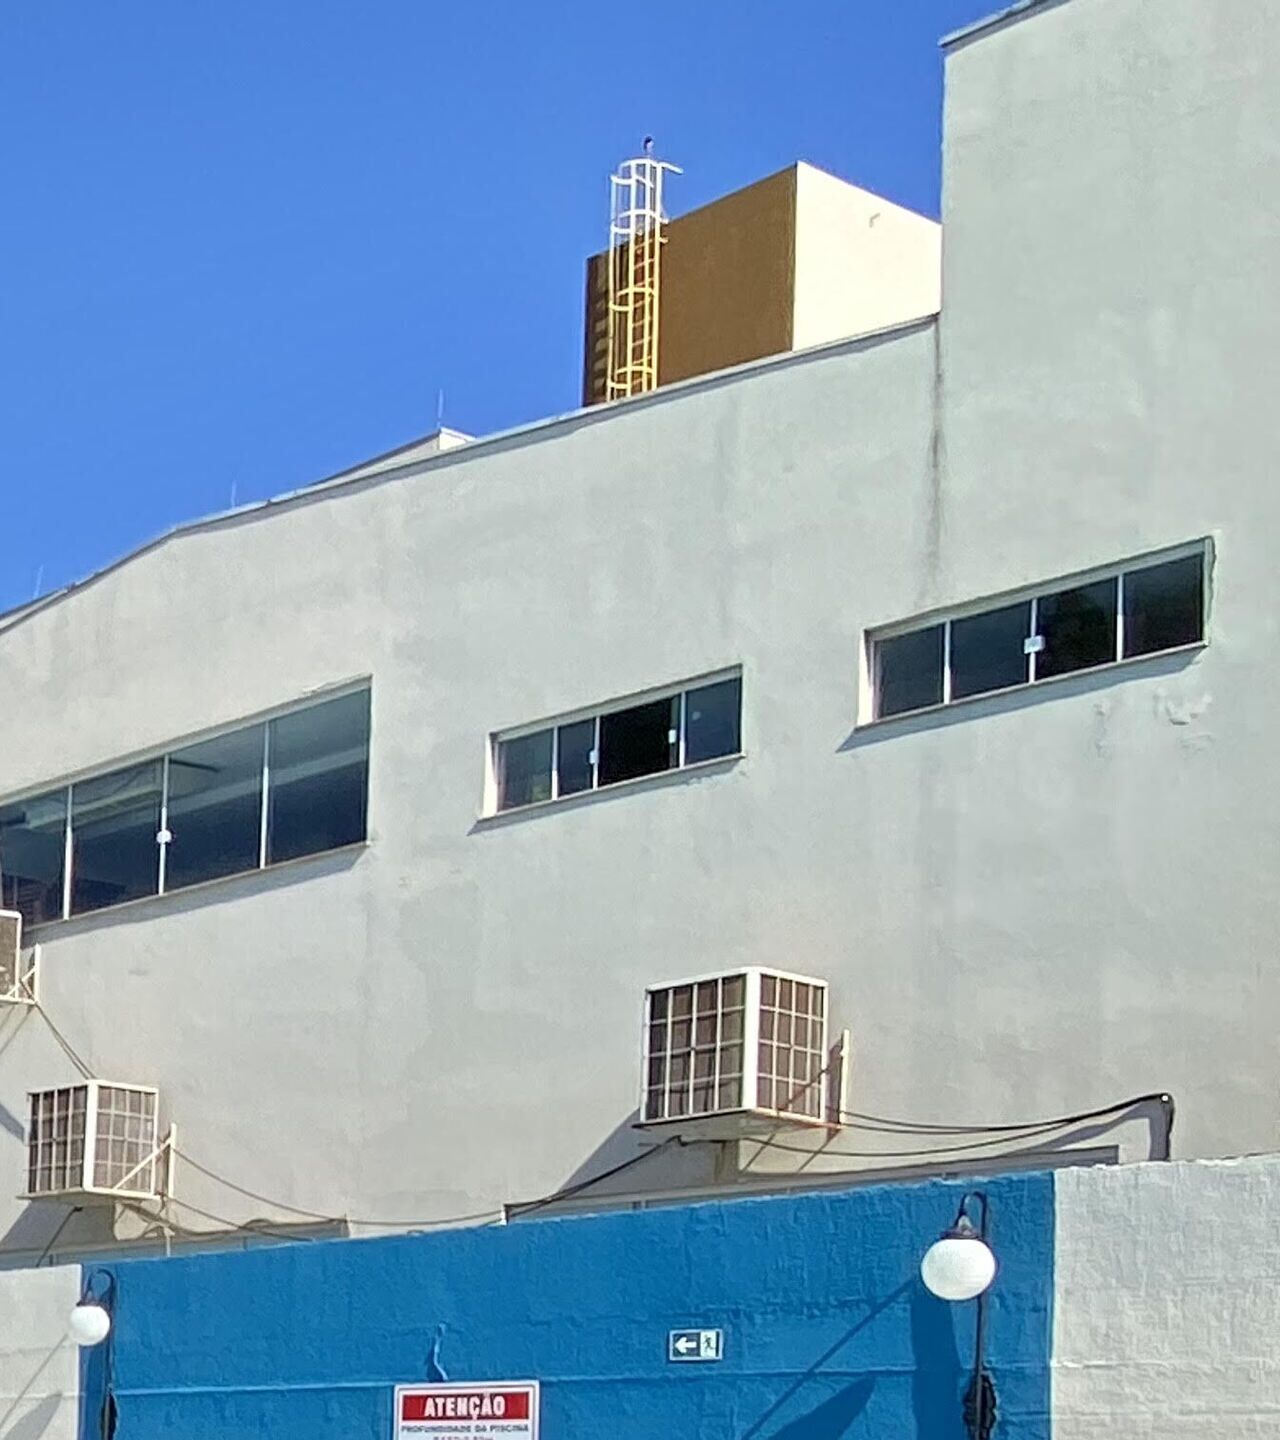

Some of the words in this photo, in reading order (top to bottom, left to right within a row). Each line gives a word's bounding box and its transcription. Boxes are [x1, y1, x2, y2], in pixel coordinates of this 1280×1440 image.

[424, 1393, 506, 1420] ATENÇÃO
[474, 1424, 487, 1433] DA
[490, 1424, 529, 1432] PISCINA
